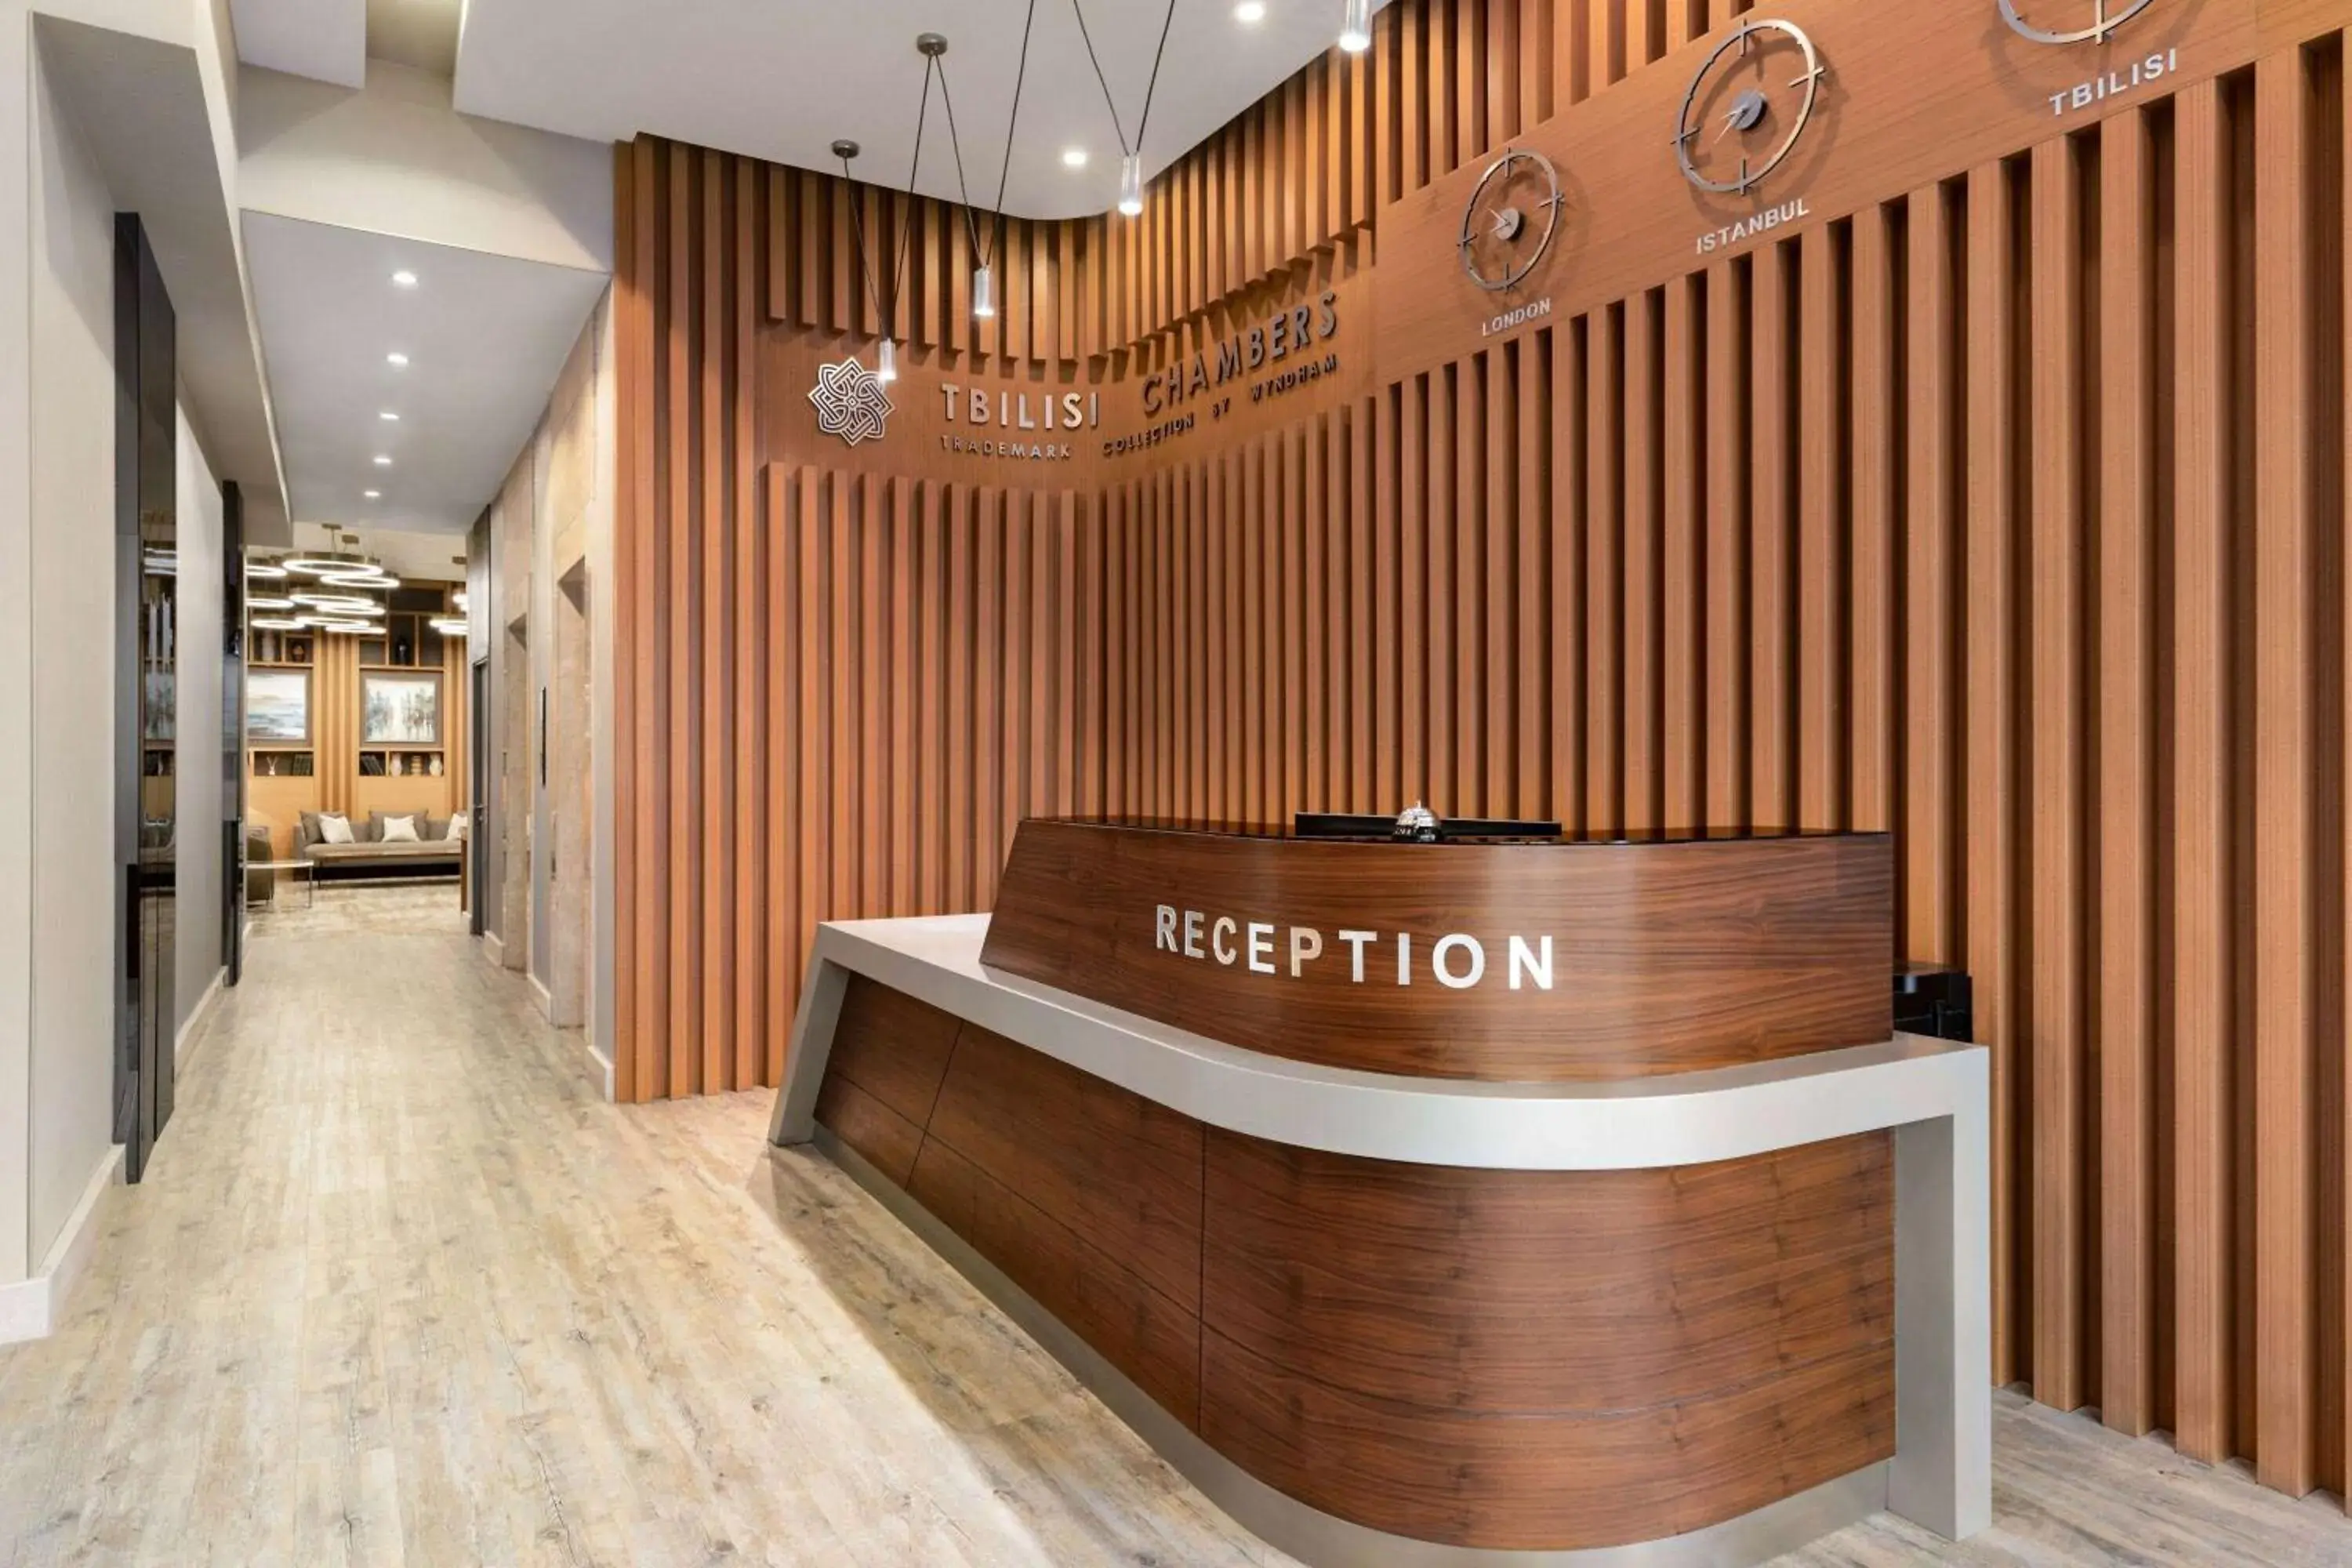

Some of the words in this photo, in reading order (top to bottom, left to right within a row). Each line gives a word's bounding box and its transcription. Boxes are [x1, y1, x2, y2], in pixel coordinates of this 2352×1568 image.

[2049, 48, 2178, 116] TBILISI
[1695, 198, 1810, 255] ISTANBUL
[1482, 297, 1552, 338] LONDON
[941, 384, 1099, 430] TBILISI
[1142, 292, 1338, 416] CHAMBERS
[941, 434, 1072, 459] TRADEMARK
[1102, 413, 1195, 455] COLLECTION
[1213, 398, 1231, 420] BY
[1252, 354, 1339, 403] WYNDHAM
[1156, 905, 1554, 990] RECEPTION
